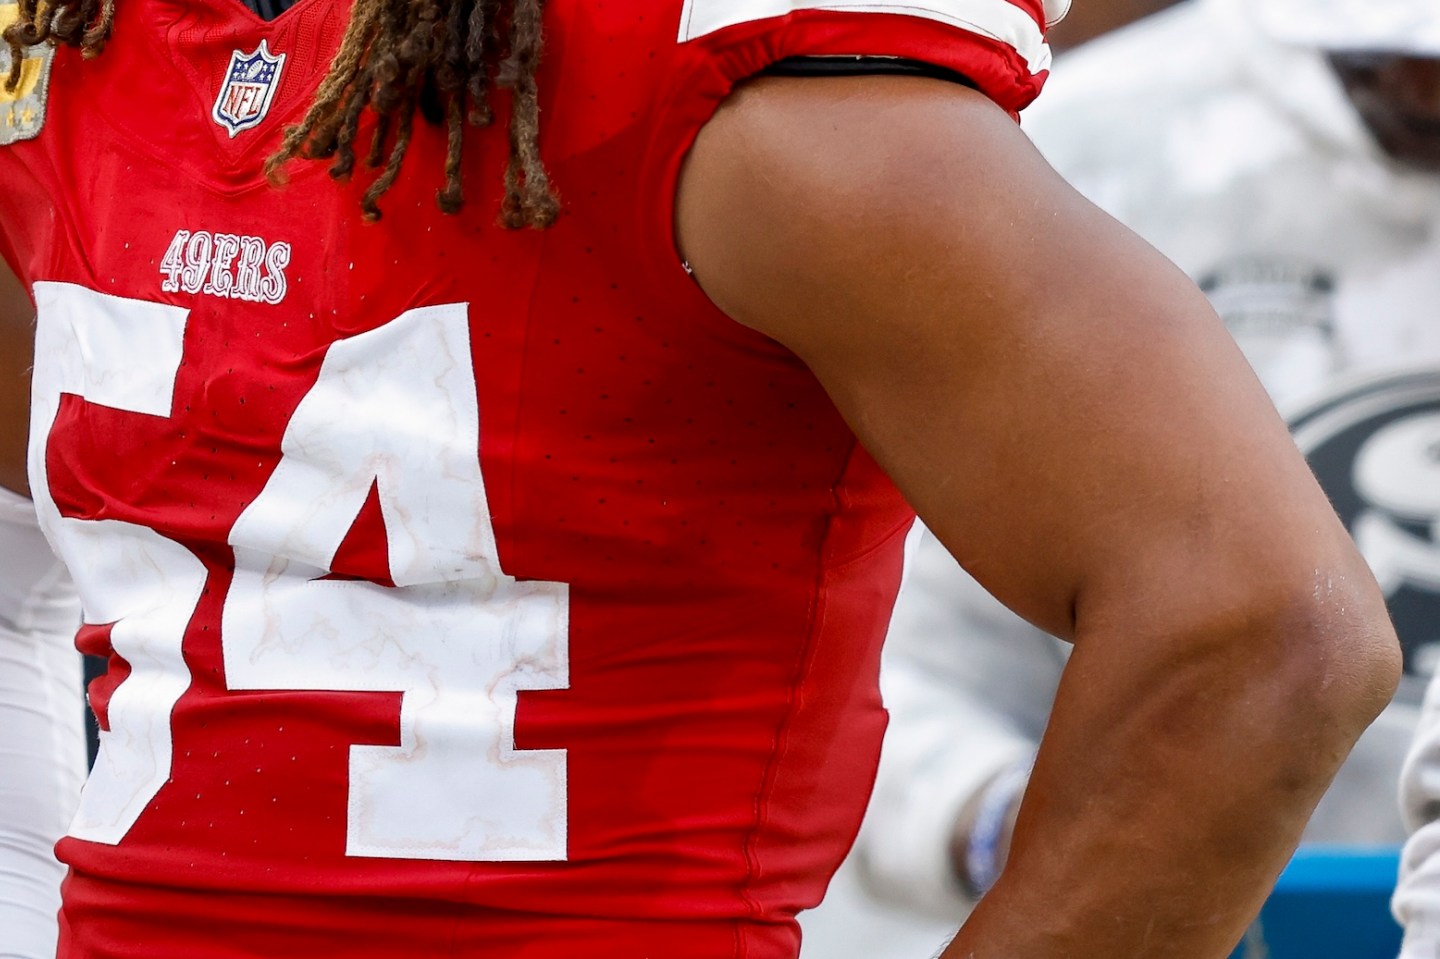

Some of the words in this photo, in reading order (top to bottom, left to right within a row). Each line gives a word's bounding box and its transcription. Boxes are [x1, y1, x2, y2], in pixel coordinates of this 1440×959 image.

[222, 85, 262, 120] NFL
[159, 229, 292, 305] 49ERS
[29, 281, 570, 862] 54
